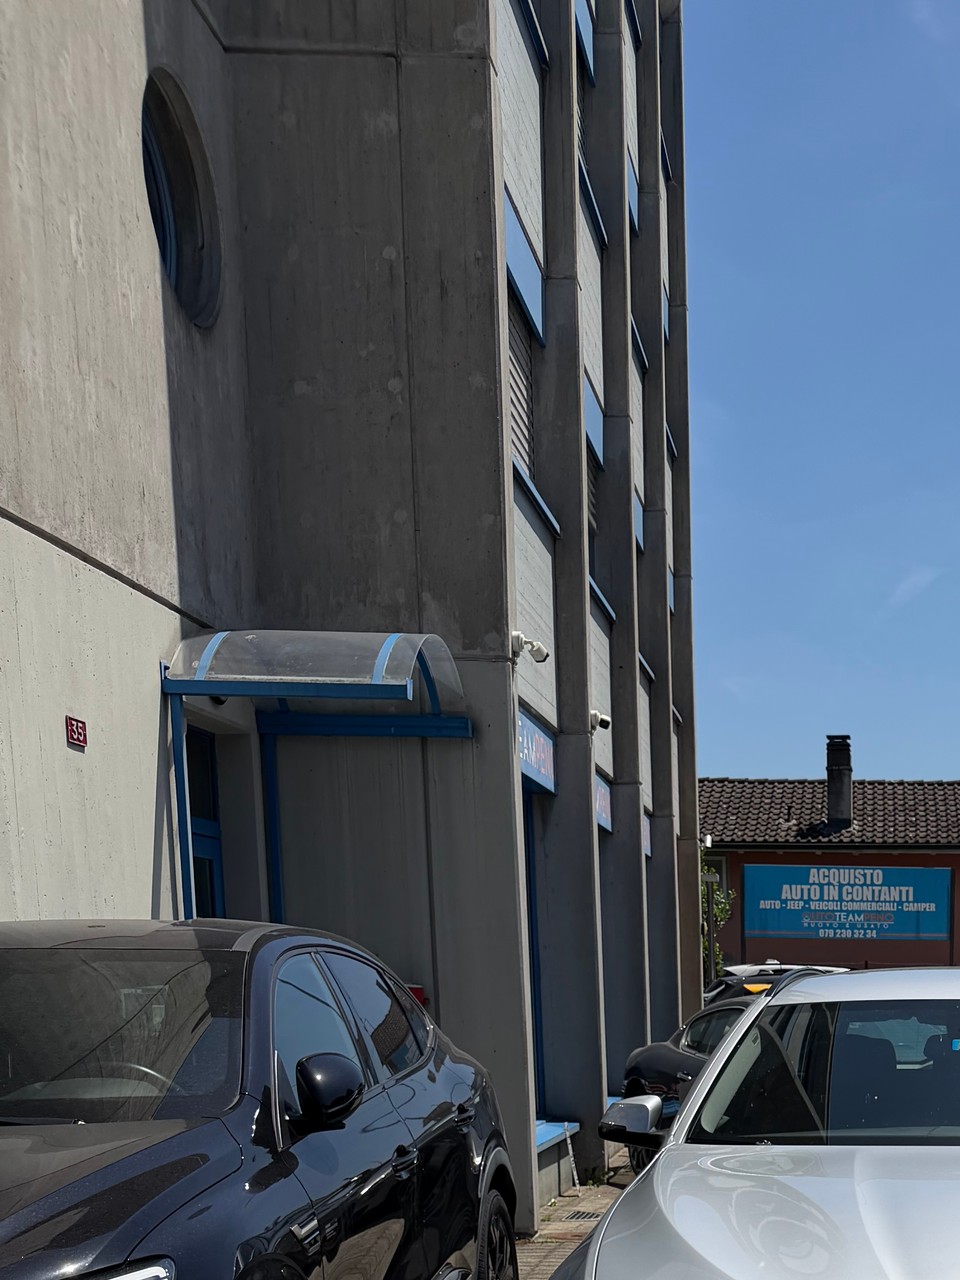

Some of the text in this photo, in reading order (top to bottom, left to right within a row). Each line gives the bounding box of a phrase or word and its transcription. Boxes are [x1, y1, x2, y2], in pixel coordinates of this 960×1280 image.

[71, 720, 84, 741] 35
[808, 868, 883, 886] ACQUISTO
[781, 884, 914, 902] AUTO IN CONTANTI
[759, 900, 781, 909] AUTO
[786, 901, 804, 910] JEEP
[809, 901, 840, 911] VEICOLI
[841, 901, 897, 911] COMMERCIALI
[903, 902, 936, 912] CAMPER
[819, 929, 877, 938] 079 230 32 34
